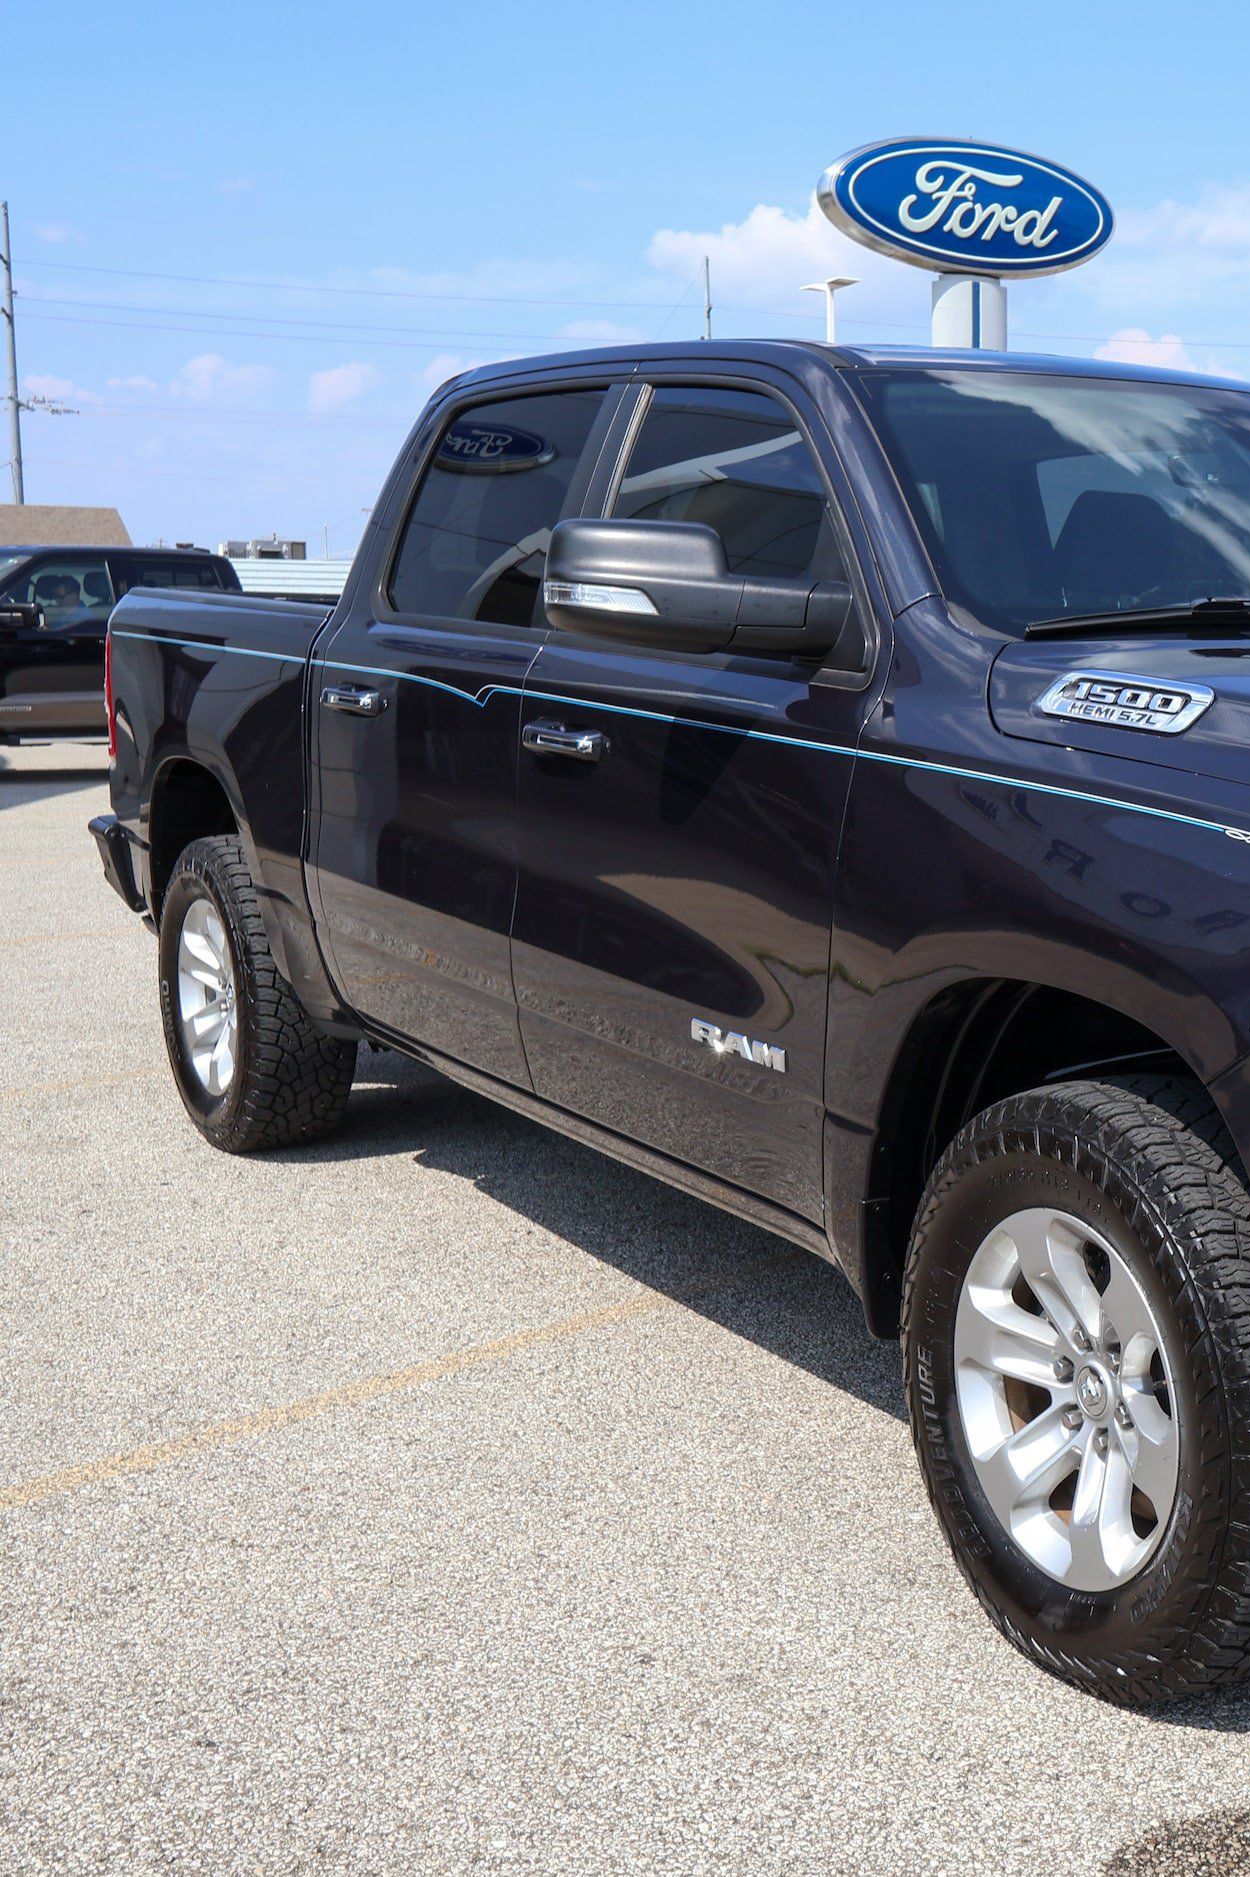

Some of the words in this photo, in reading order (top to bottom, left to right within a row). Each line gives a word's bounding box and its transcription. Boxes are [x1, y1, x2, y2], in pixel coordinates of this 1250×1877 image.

[899, 160, 1063, 248] Ford
[1069, 702, 1114, 721] HEMI
[1117, 709, 1158, 726] 5.7L
[1073, 681, 1187, 714] 1500
[690, 1017, 787, 1074] RAM
